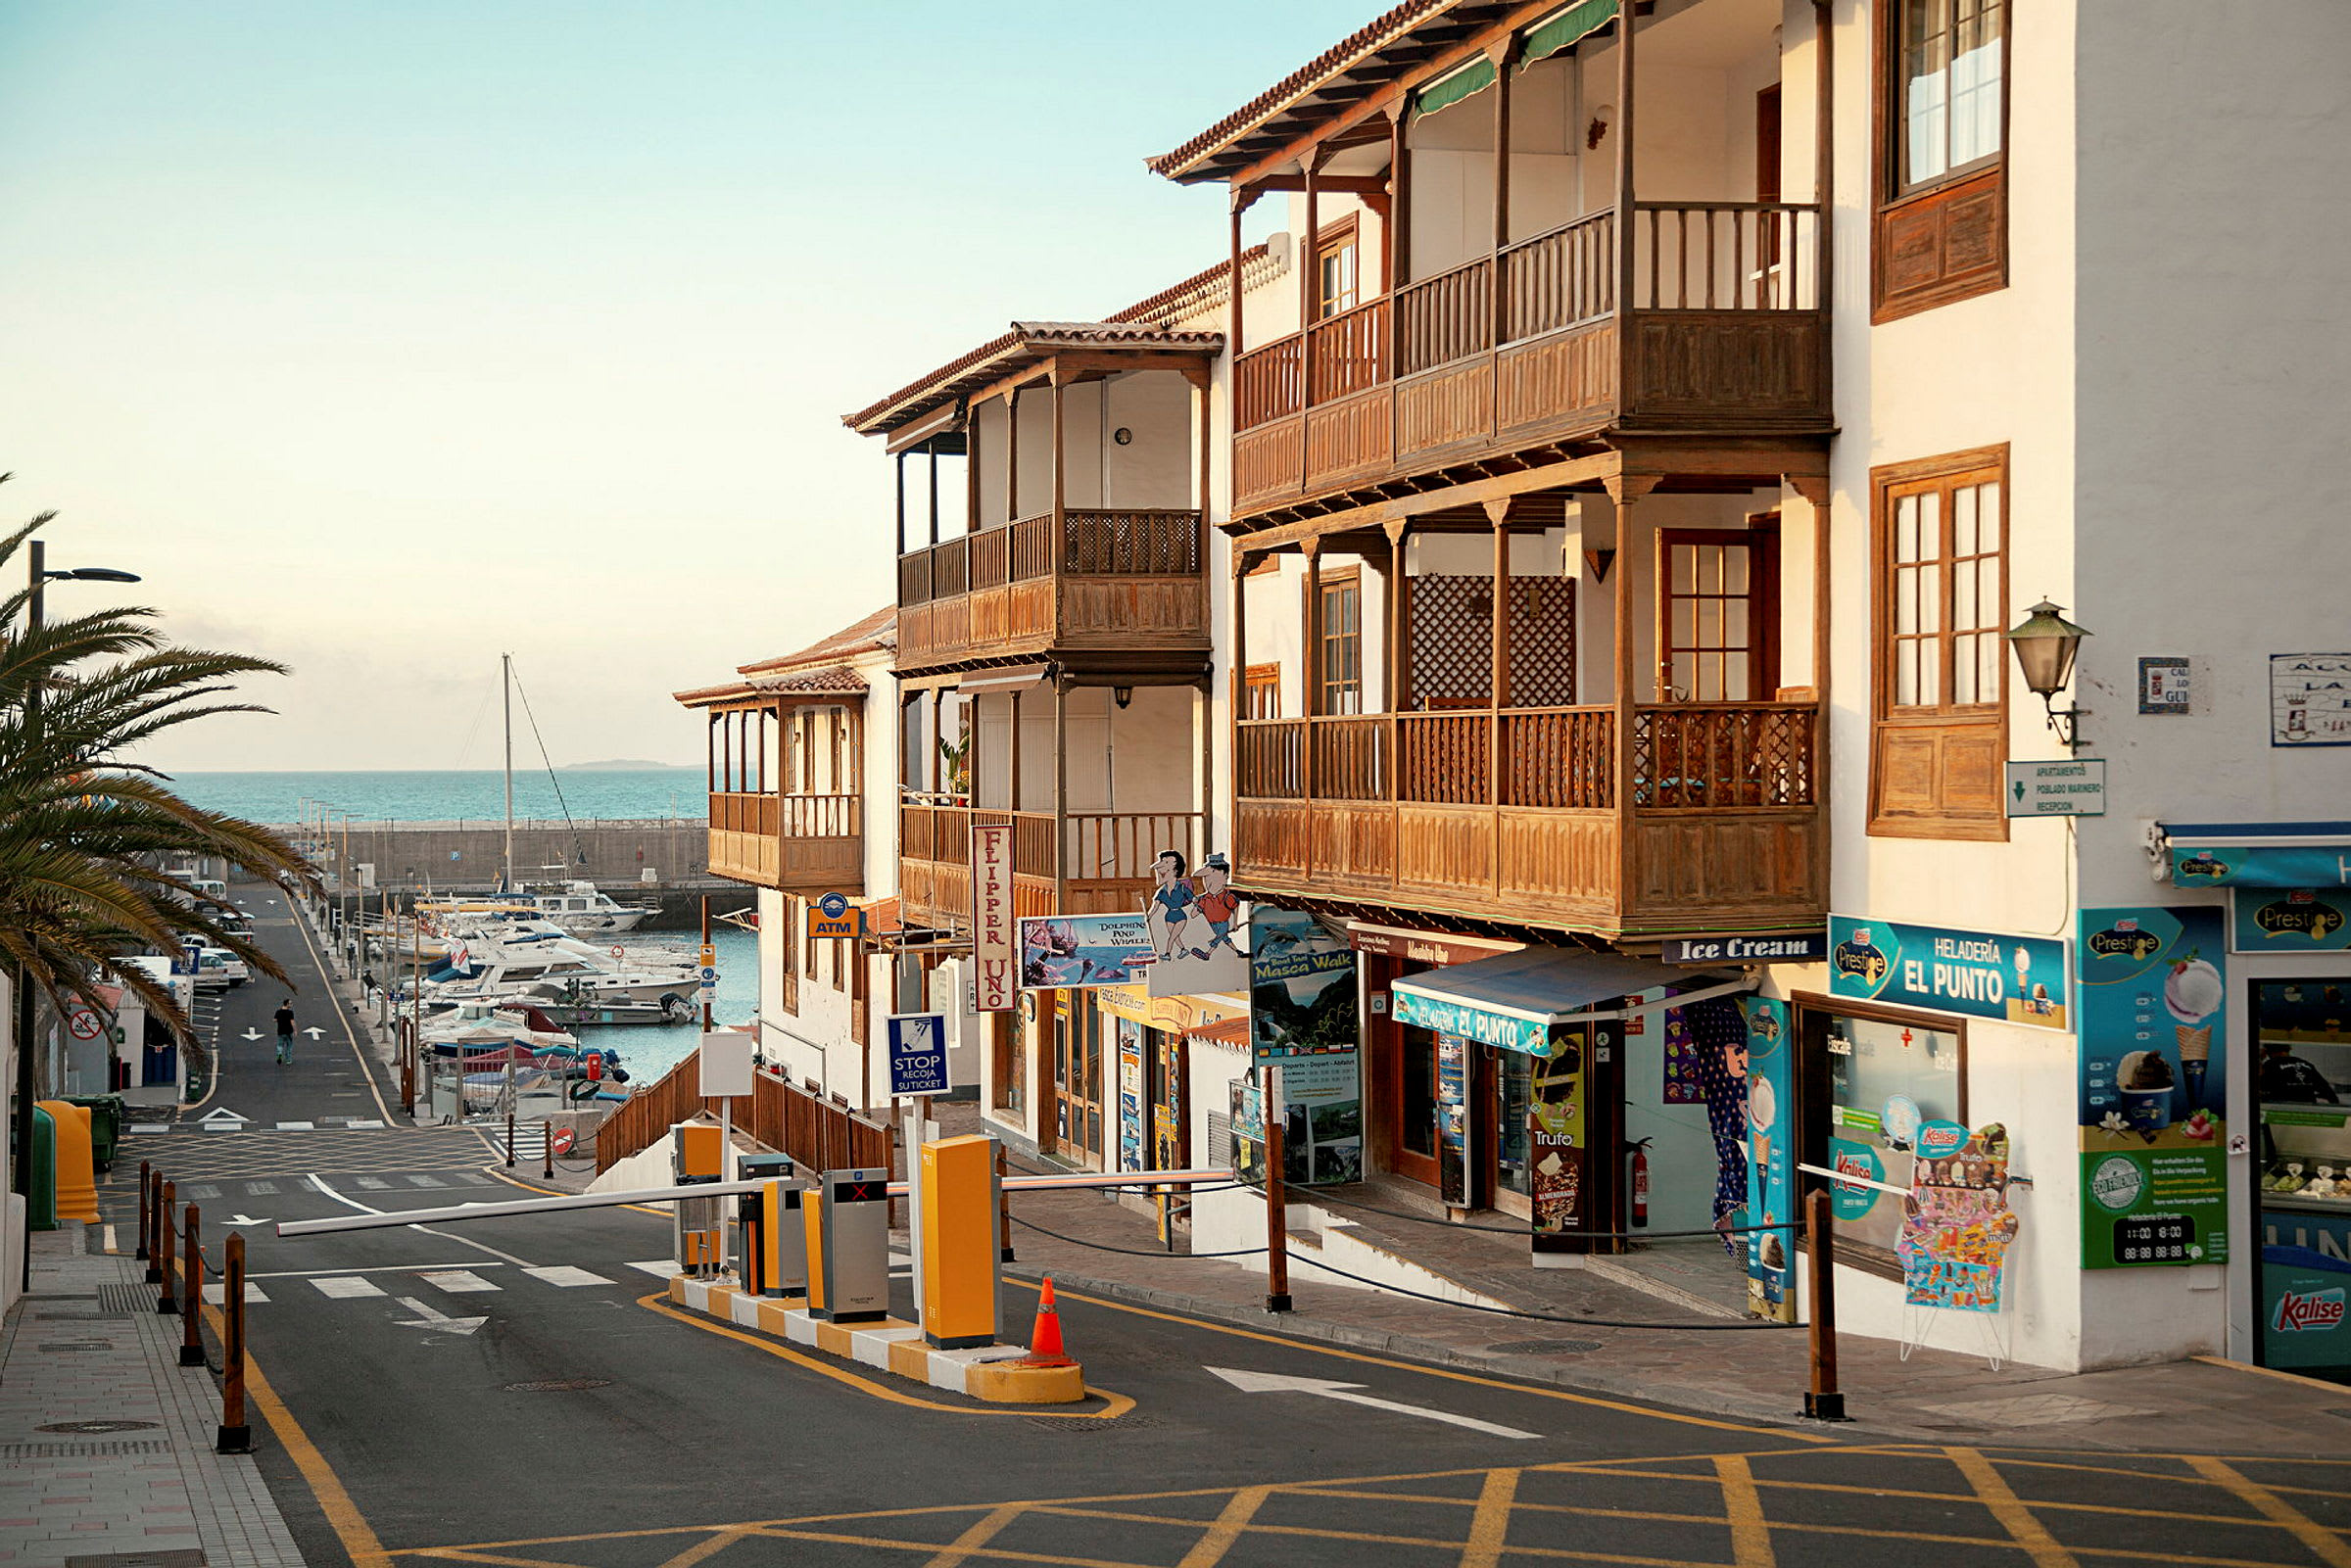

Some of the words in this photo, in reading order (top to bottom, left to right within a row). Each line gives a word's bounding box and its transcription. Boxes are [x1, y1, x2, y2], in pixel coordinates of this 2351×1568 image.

[984, 831, 1005, 945] FLIPPER
[816, 923, 851, 933] ATM
[1680, 940, 1720, 960] Ice
[1726, 938, 1809, 958] Cream
[1935, 937, 2002, 965] HELADERÍA
[1255, 964, 1310, 979] Masca
[1312, 953, 1352, 970] Walk
[984, 959, 1007, 1008] UNO
[1903, 960, 1929, 994] EL
[1934, 963, 2004, 1004] PUNTO
[1458, 1010, 1473, 1036] EL
[1476, 1015, 1518, 1047] PUNTO
[894, 1056, 940, 1070] STOP
[902, 1069, 936, 1079] RECOJA
[898, 1081, 910, 1090] SU
[910, 1079, 941, 1089] TICKET
[1535, 1131, 1573, 1146] Trufo
[1923, 1127, 1959, 1145] Kalise
[2279, 1292, 2344, 1331] Kalise
